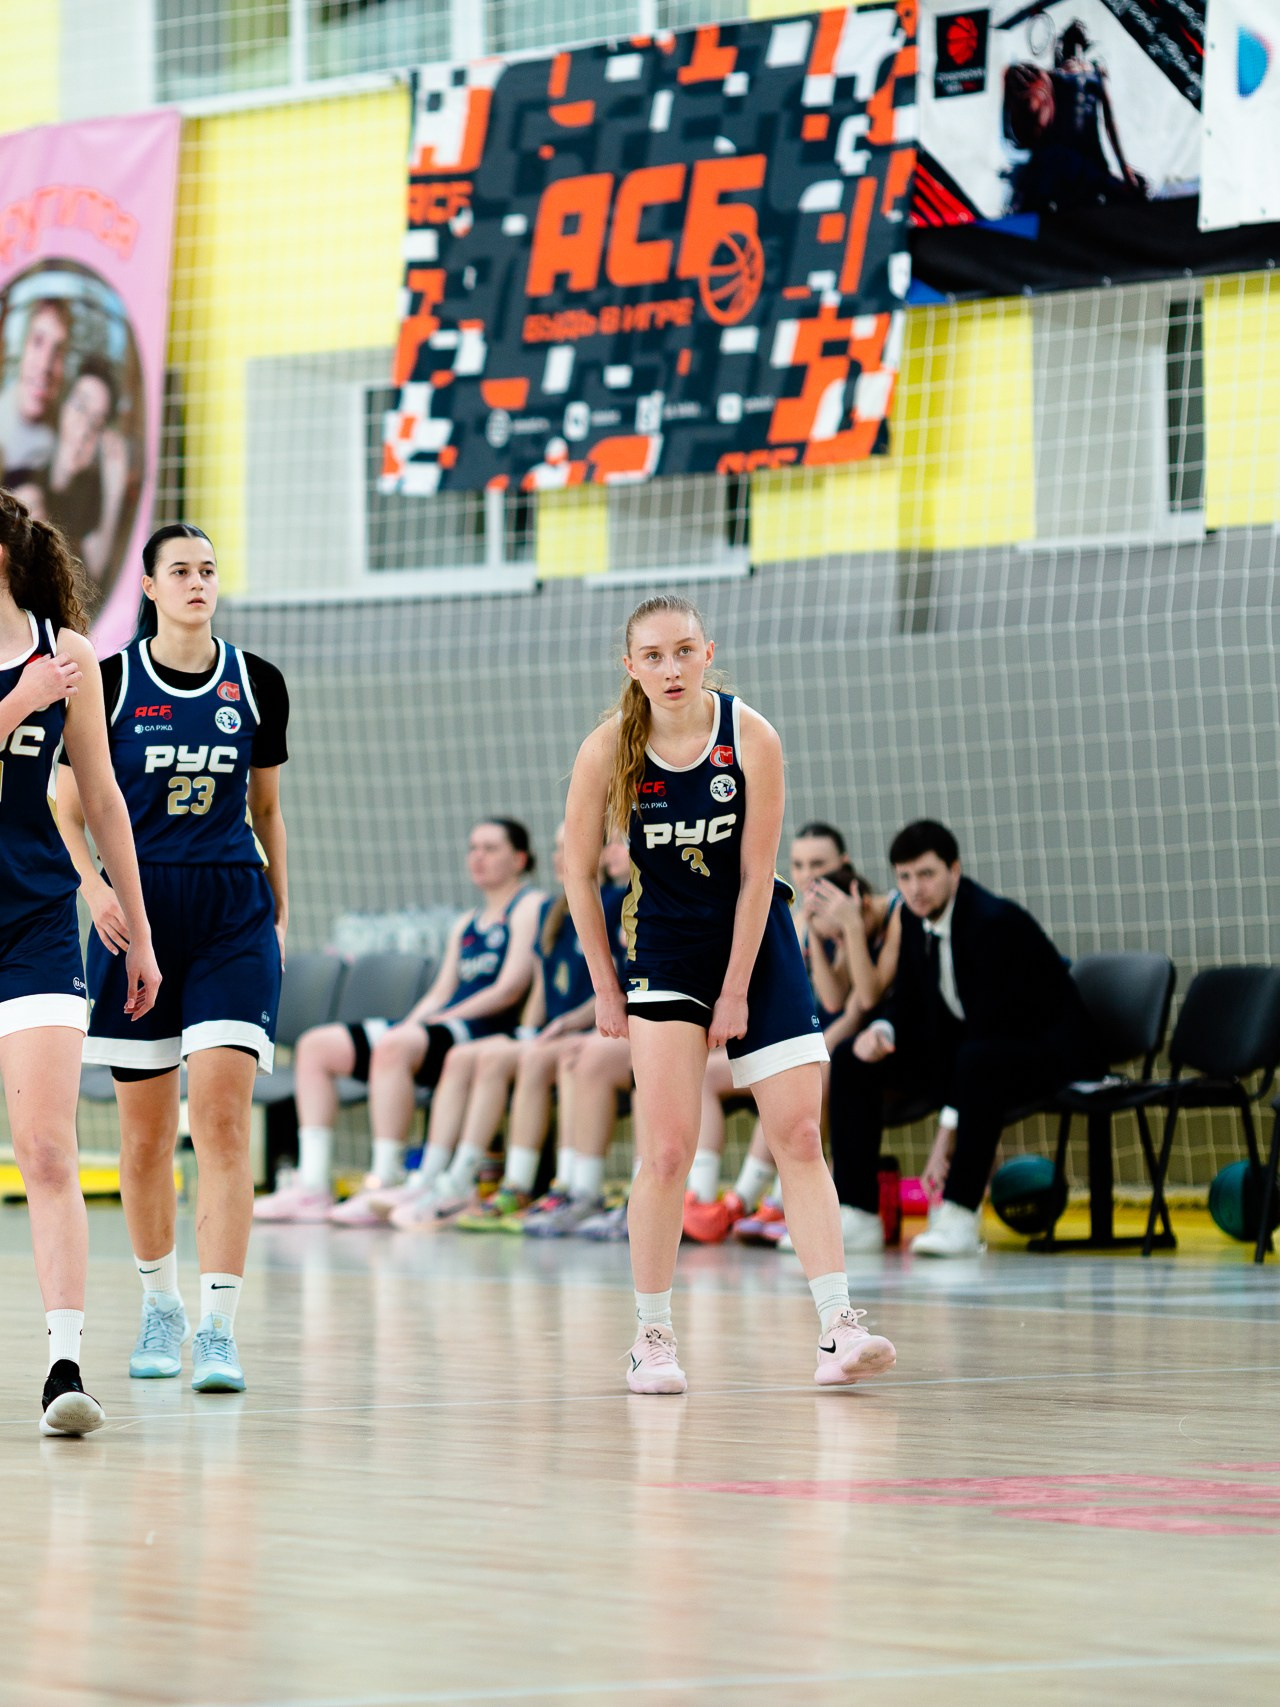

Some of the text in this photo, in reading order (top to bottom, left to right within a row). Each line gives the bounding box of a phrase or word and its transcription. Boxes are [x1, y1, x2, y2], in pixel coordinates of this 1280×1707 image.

[525, 153, 767, 325] АСБ
[623, 297, 694, 332] ИГРЕ
[134, 705, 173, 720] АСБ
[145, 745, 238, 773] РУС
[167, 776, 216, 815] 23
[651, 801, 668, 809] РЖД
[643, 813, 737, 849] РУС
[681, 847, 710, 877] 3
